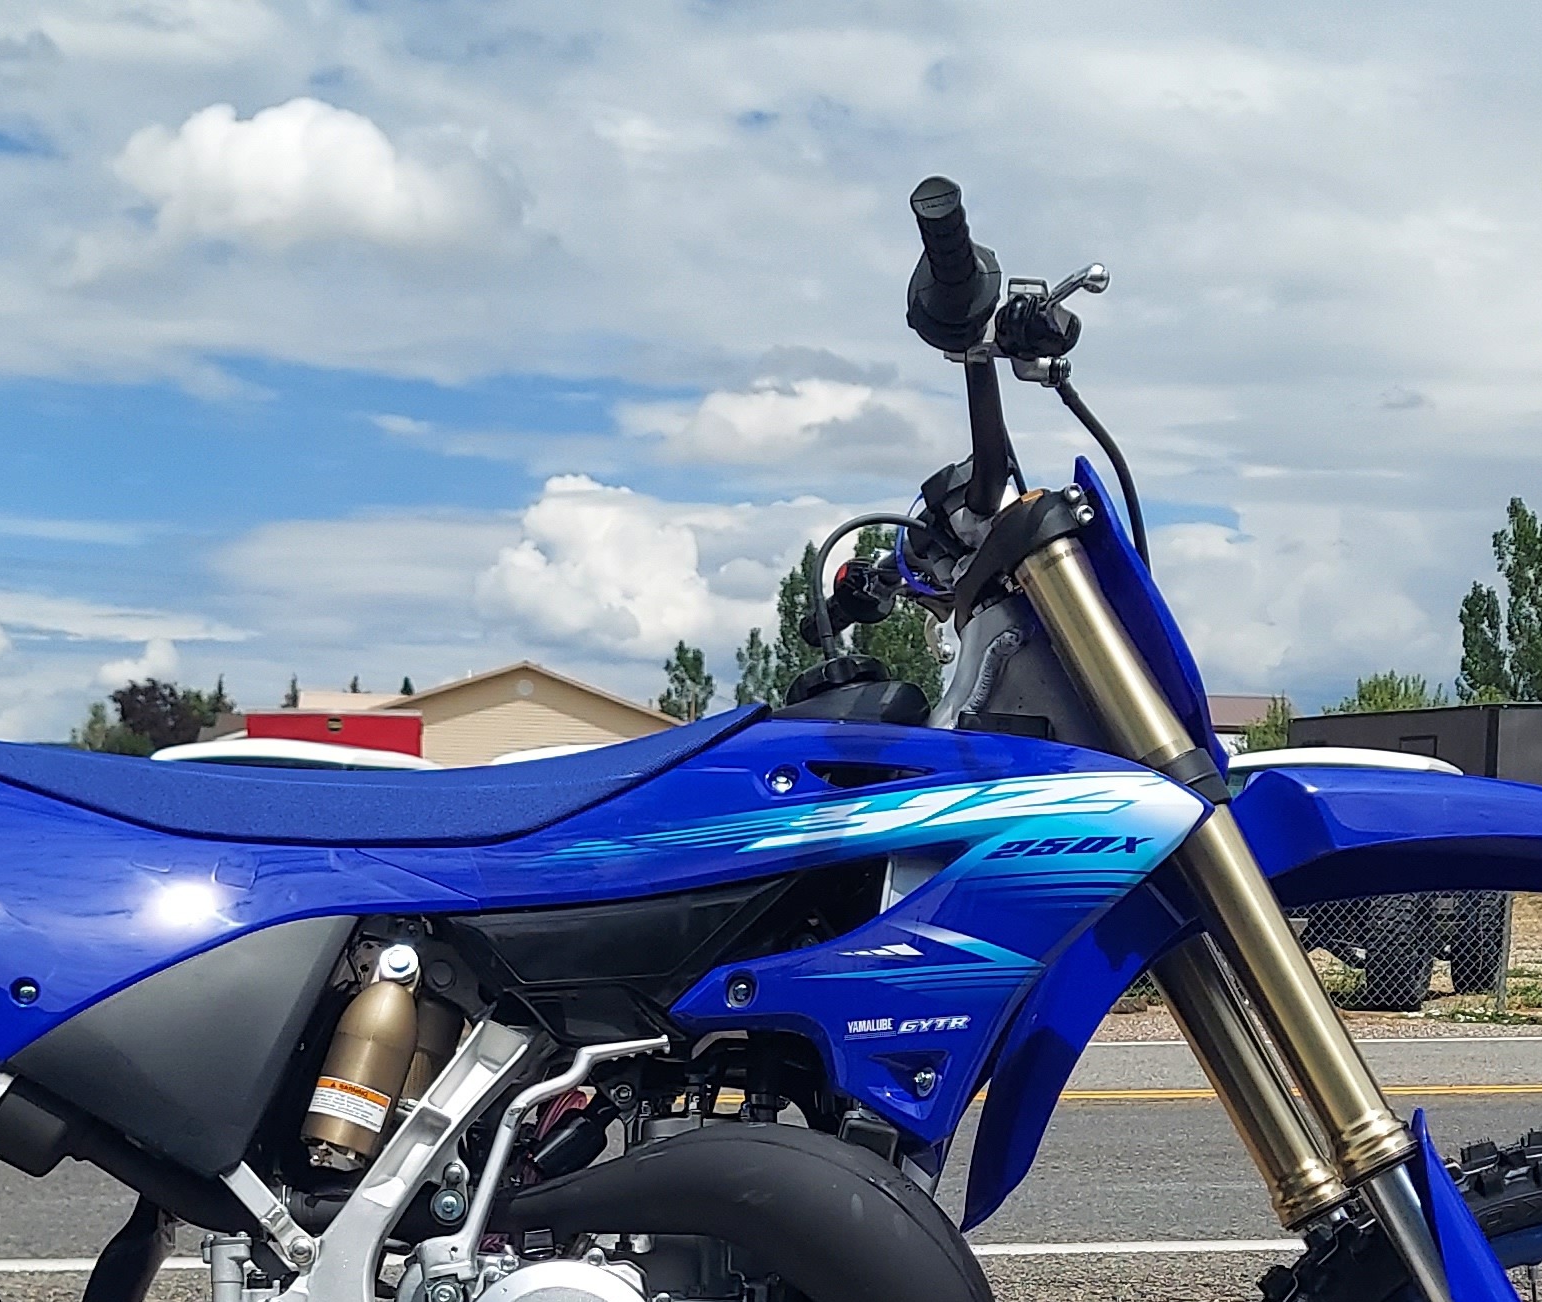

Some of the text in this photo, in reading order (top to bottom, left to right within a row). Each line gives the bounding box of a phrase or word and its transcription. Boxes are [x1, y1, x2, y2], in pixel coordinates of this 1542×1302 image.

[982, 836, 1156, 861] 250X
[847, 1018, 895, 1033] YAMALUBE
[897, 1015, 971, 1034] GYTR
